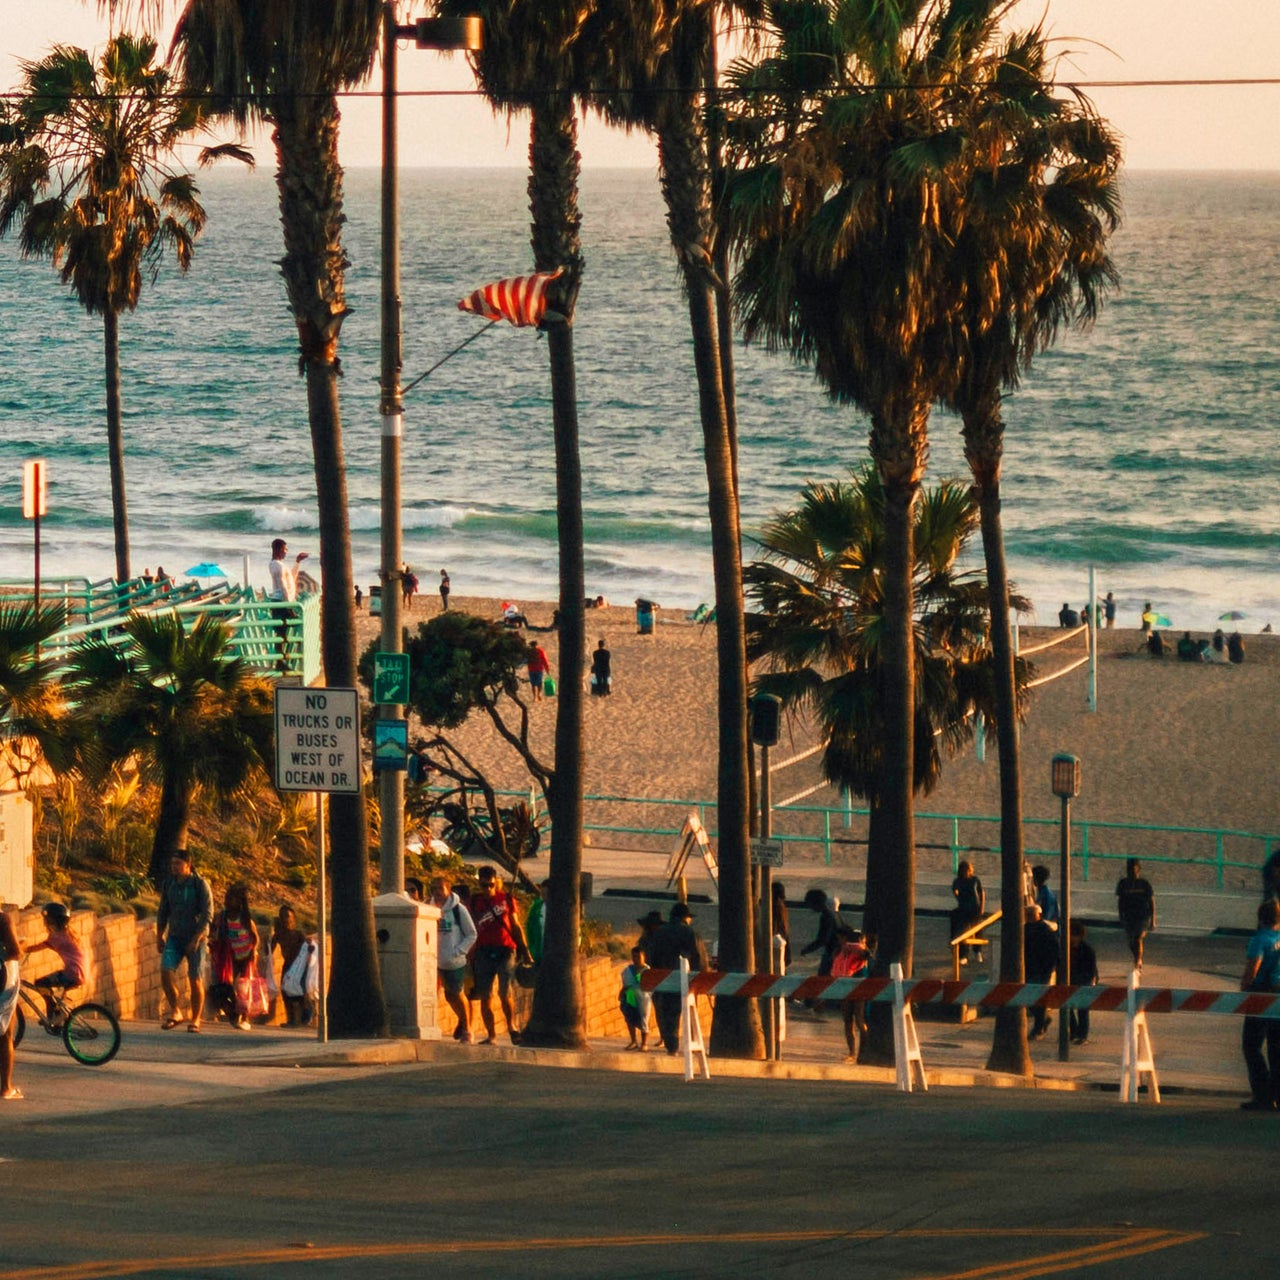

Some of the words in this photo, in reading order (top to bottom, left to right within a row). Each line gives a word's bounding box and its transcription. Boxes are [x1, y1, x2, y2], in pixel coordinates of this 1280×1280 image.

[306, 695, 327, 710] NO
[283, 714, 329, 728] TRUCKS
[335, 716, 352, 729] OR
[297, 734, 338, 748] BUSES
[291, 752, 322, 766] WEST
[329, 753, 344, 767] OF
[285, 771, 325, 786] OCEAN
[331, 772, 351, 787] DR.
